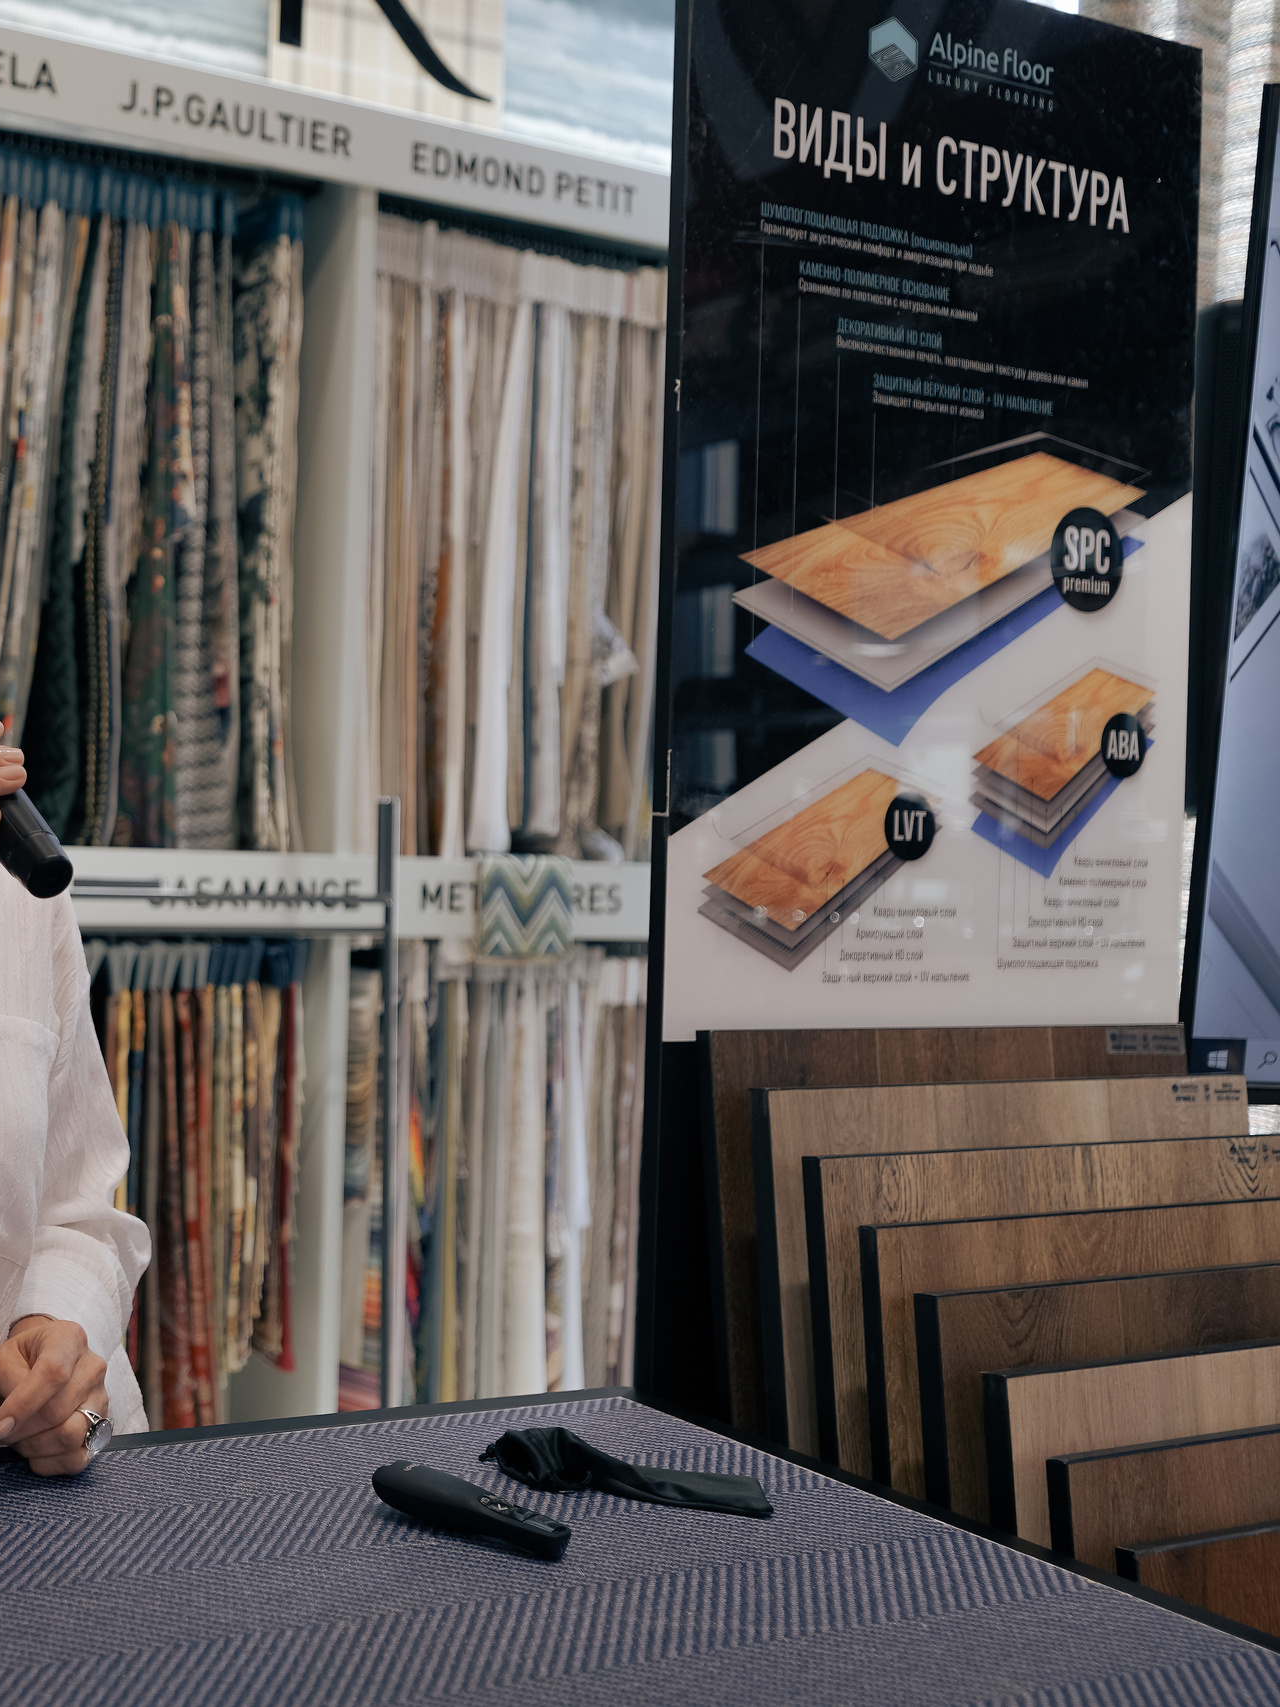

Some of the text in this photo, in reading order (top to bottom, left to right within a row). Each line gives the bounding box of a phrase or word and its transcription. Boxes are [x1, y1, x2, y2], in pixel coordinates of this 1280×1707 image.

[929, 31, 1055, 86] Alpine floor
[927, 69, 1055, 112] LUXURY FLOORING
[121, 81, 353, 158] J.P.GAULTIER
[410, 141, 638, 216] EDMOND PETIT
[773, 97, 1130, 233] ВИДЫ и СТРУКТУРА
[760, 201, 973, 259] ШУМОПОГЛОЩАЮЩАЯ ПОДЛОЖКА (опциональна)
[760, 219, 994, 278] Гарантирует акустический комфорт и амортизацию при ходьбе
[799, 259, 951, 302] КАМЕННО-ПОЛИМЕРНОЕ ОСНОВАНИЕ
[798, 277, 978, 322] Сравнимое по плотности с натуральным камнем
[837, 316, 943, 350] ДЕКОРАТИВНЫЙ HD СЛОЙ
[836, 334, 915, 360] Высококачественная
[945, 355, 994, 373] повторяющая
[995, 363, 1026, 379] текстуру
[1027, 369, 1051, 383] дерева
[1053, 374, 1066, 385] или
[1067, 376, 1089, 389] камня
[872, 390, 911, 409] Защищает
[950, 405, 958, 416] от
[959, 406, 984, 420] износа
[873, 372, 921, 394] ЗАЩИТНЫЙ
[923, 381, 961, 401] ВЕРХНИЙ
[962, 386, 985, 405] СЛОЙ
[993, 392, 1005, 408] UV
[1006, 394, 1054, 416] НАПЫЛЕНИЕ
[1063, 525, 1111, 575] SPC
[1062, 575, 1110, 595] premium
[893, 809, 927, 841] LVT
[1133, 857, 1149, 869] слой
[1132, 877, 1147, 889] слой
[940, 906, 957, 917] слой
[1028, 915, 1076, 929] Декоративный
[856, 928, 924, 941] Армирующий слой
[1012, 936, 1048, 949] Защитный
[1050, 938, 1076, 950] верхний
[1078, 937, 1094, 948] слой
[839, 948, 924, 962] Декоративный HD слой
[1066, 960, 1099, 970] подложка
[863, 971, 893, 984] верхний
[895, 971, 912, 983] слой
[920, 972, 930, 982] UV
[931, 972, 970, 983] напыление
